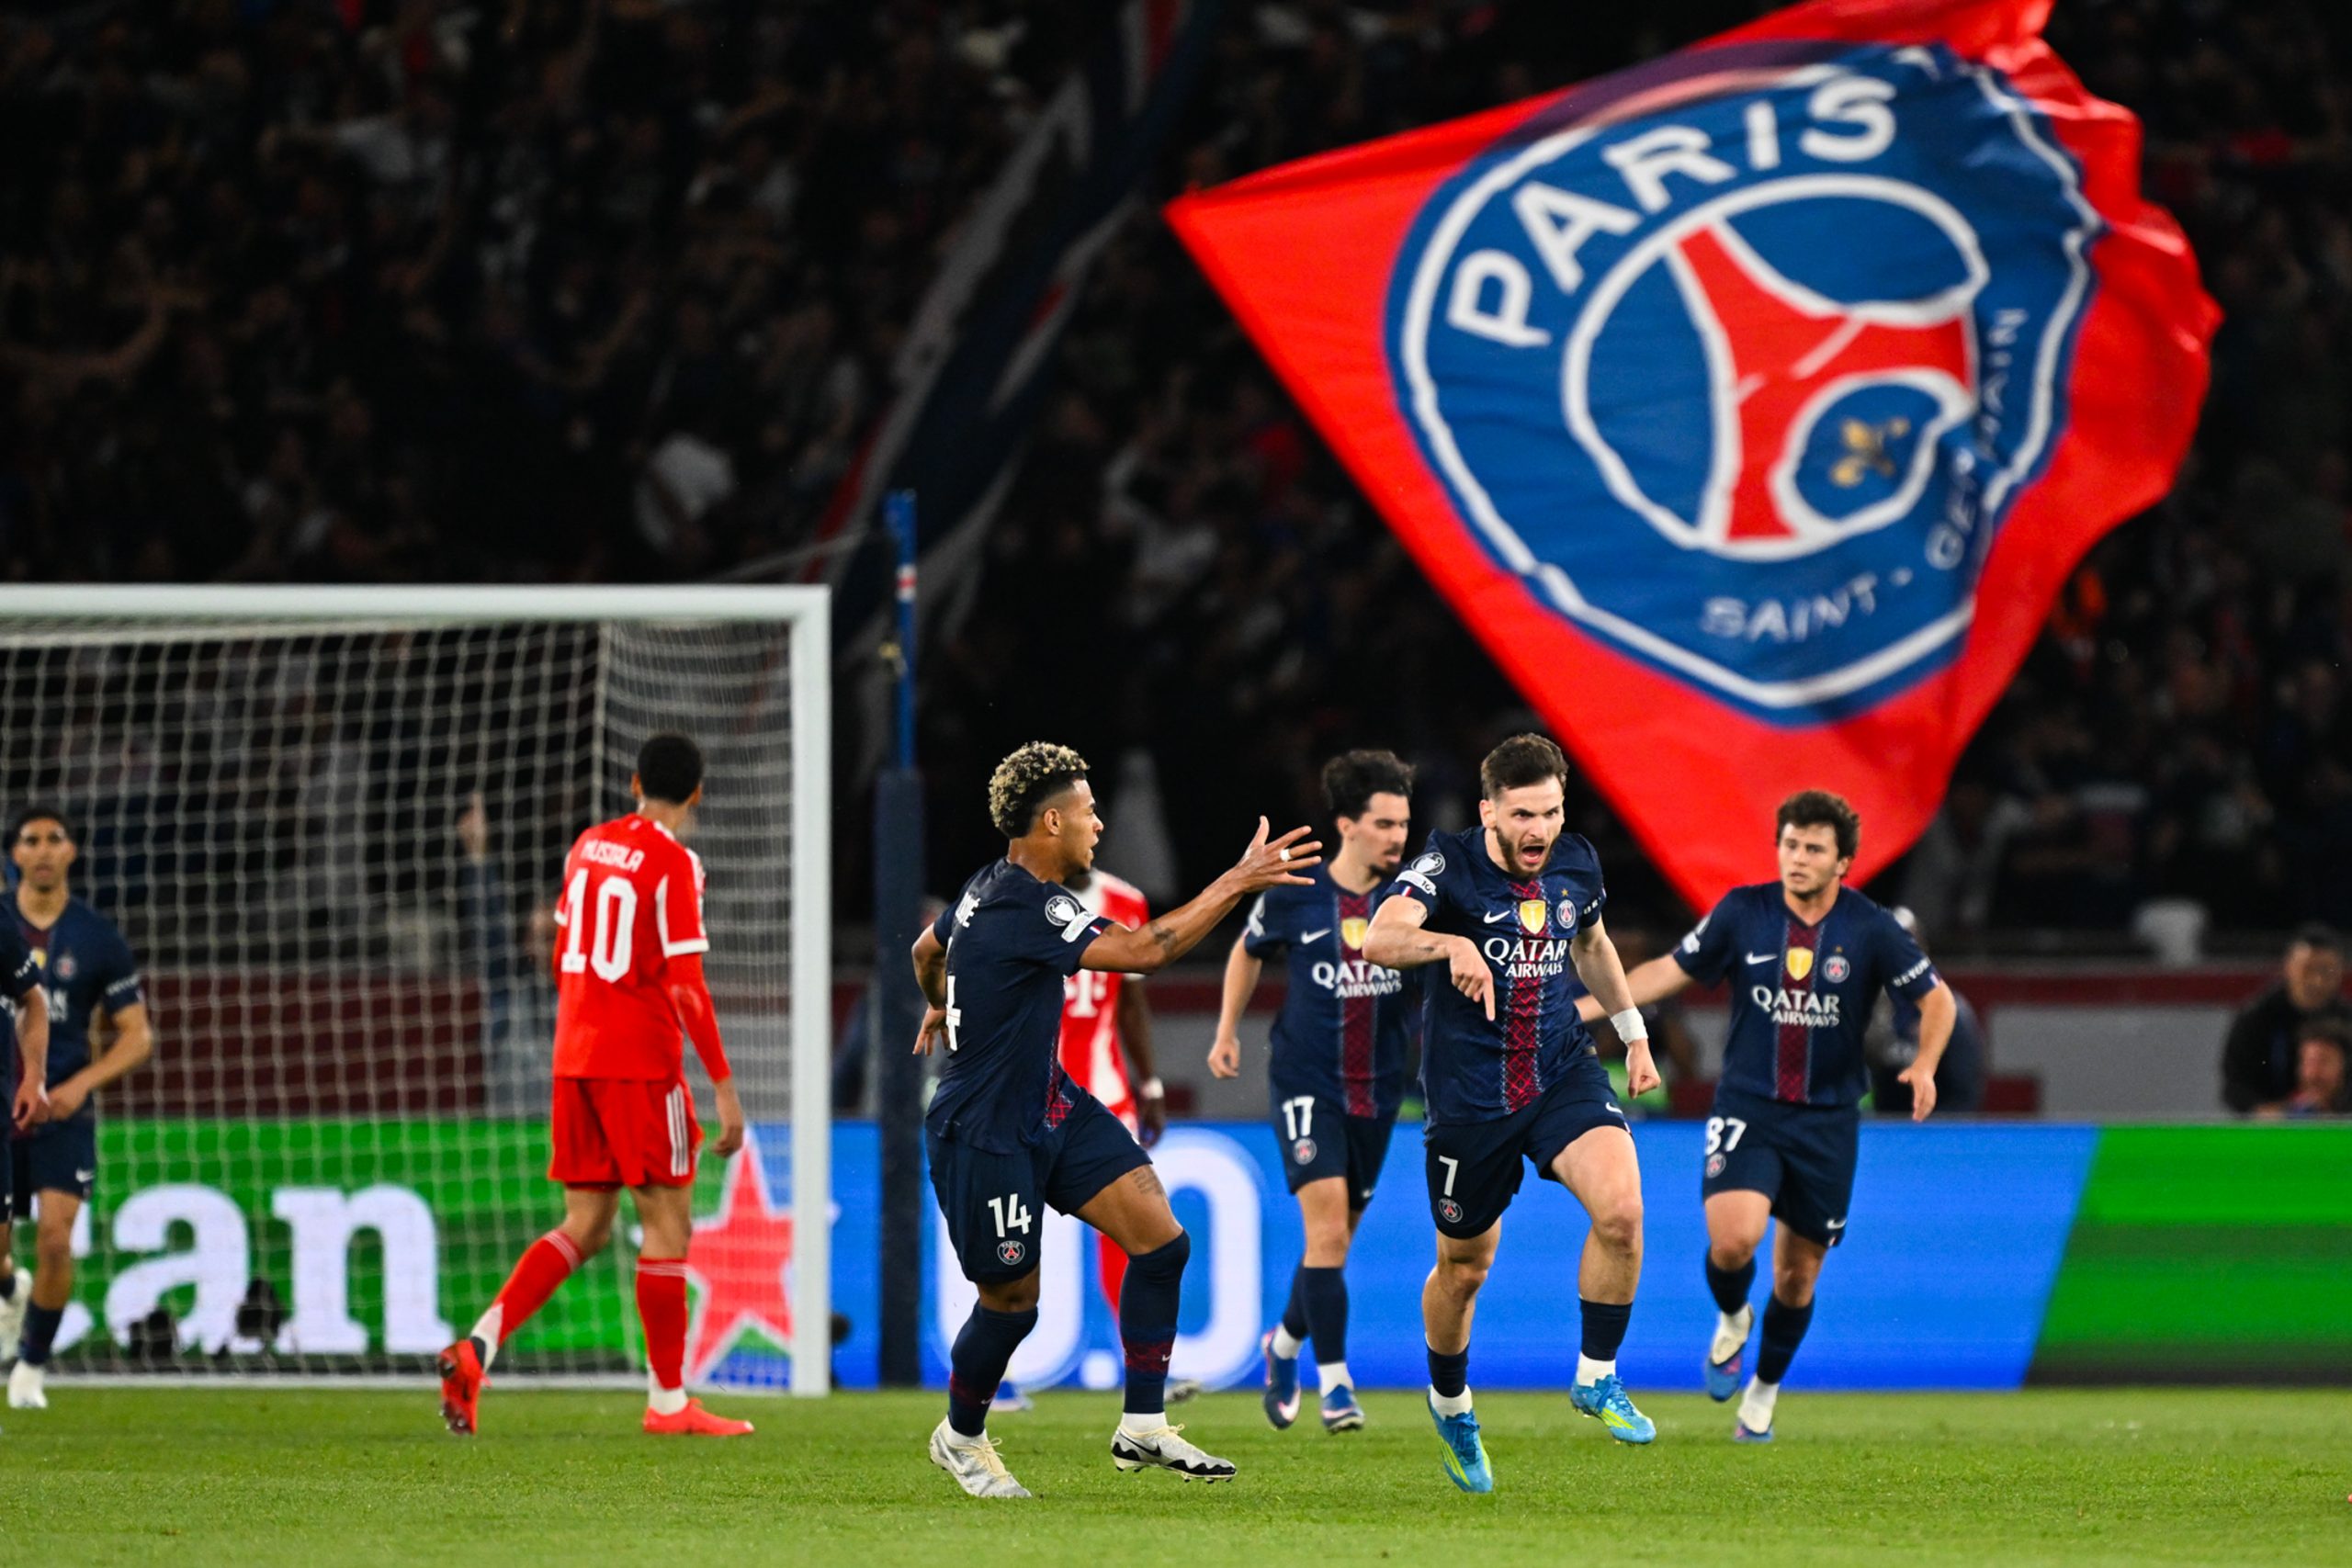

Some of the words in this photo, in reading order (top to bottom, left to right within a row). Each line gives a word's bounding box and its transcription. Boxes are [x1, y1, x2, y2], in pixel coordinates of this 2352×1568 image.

[1446, 76, 1897, 347] PARIS
[561, 867, 638, 984] 10
[1484, 937, 1567, 965] QATAR
[1312, 961, 1401, 990] QATAR
[1505, 959, 1565, 978] AIRWAYS
[1335, 979, 1403, 998] AIRWAYS
[1751, 985, 1840, 1013] QATAR
[1771, 1010, 1840, 1027] AIRWAYS
[1282, 1094, 1316, 1141] 17
[1705, 1116, 1747, 1156] 87
[1439, 1155, 1459, 1197] 7
[988, 1192, 1033, 1238] 14
